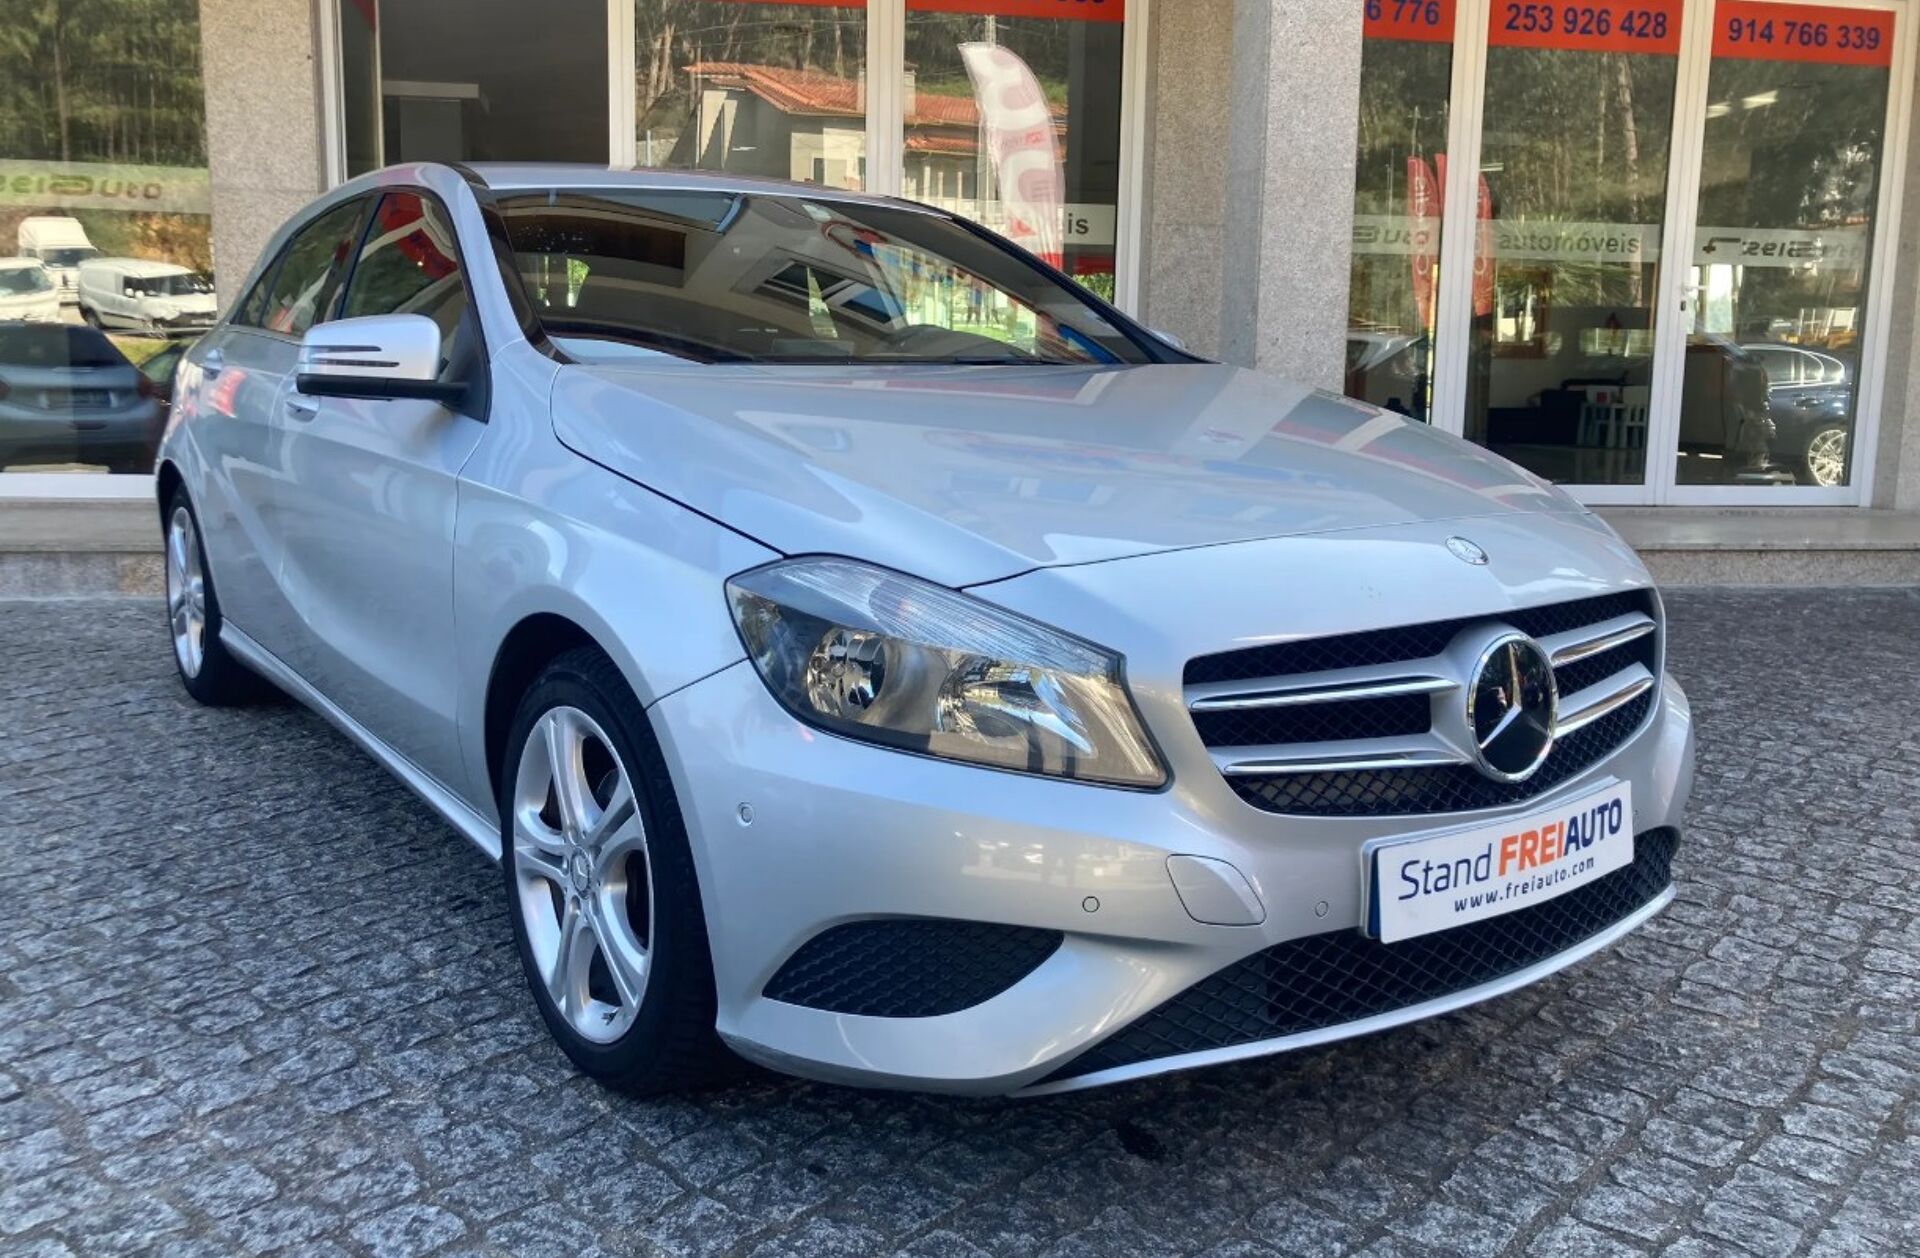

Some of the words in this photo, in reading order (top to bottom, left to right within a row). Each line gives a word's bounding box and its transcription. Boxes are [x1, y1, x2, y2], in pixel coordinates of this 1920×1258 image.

[1393, 0, 1440, 25] 776
[1505, 3, 1553, 33] 253
[1563, 7, 1611, 36] 926
[1620, 10, 1667, 38] 428
[1728, 17, 1774, 43] 914
[1784, 21, 1828, 47] 766
[1837, 25, 1880, 50] 339
[1499, 231, 1641, 254] automóveis
[1398, 844, 1492, 900] Stand
[1498, 797, 1623, 877] FREIAUTO
[1454, 857, 1595, 912] www.freiauto.com
